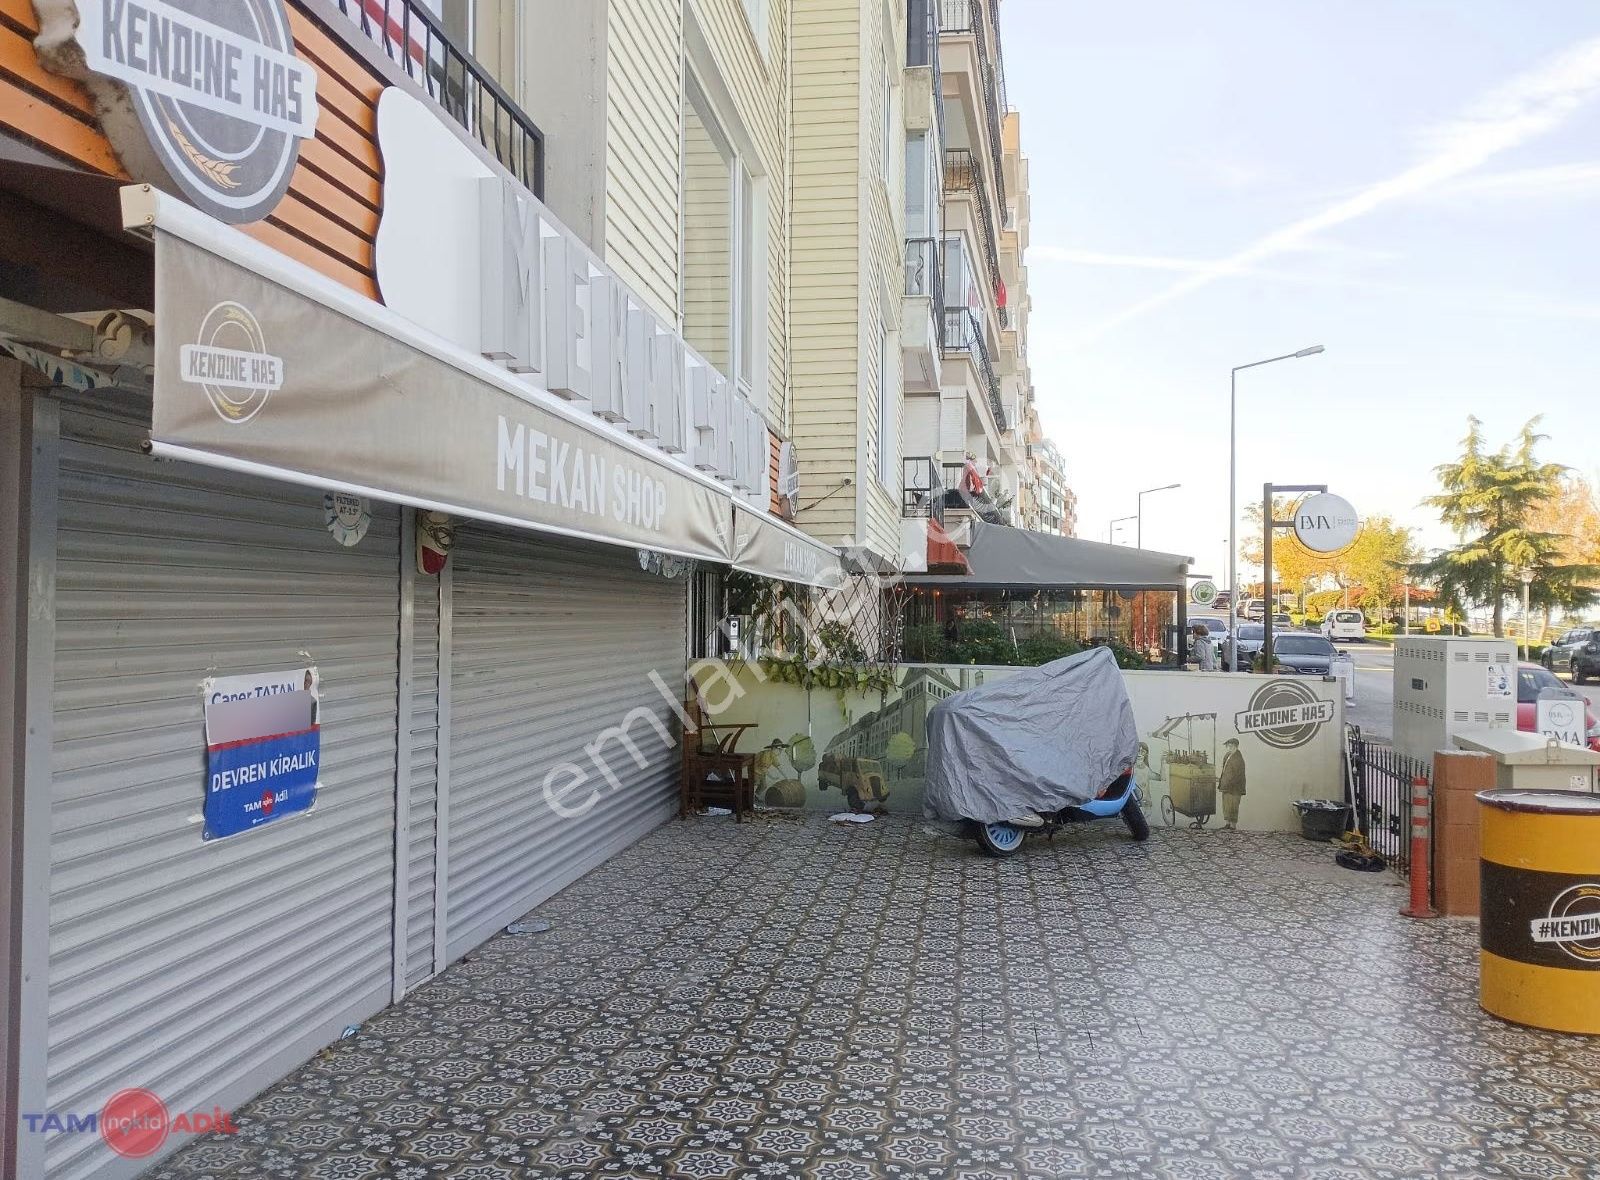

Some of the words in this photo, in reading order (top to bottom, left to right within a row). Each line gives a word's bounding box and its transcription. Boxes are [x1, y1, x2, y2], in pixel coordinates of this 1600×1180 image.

[253, 53, 303, 125] HAS
[251, 358, 276, 385] HAS
[496, 414, 606, 517] MEKAN
[612, 463, 667, 531] SHOP
[1302, 704, 1326, 721] HAS
[211, 760, 267, 793] DEVREN
[270, 749, 316, 777] KİRALIK
[244, 800, 262, 813] TAM
